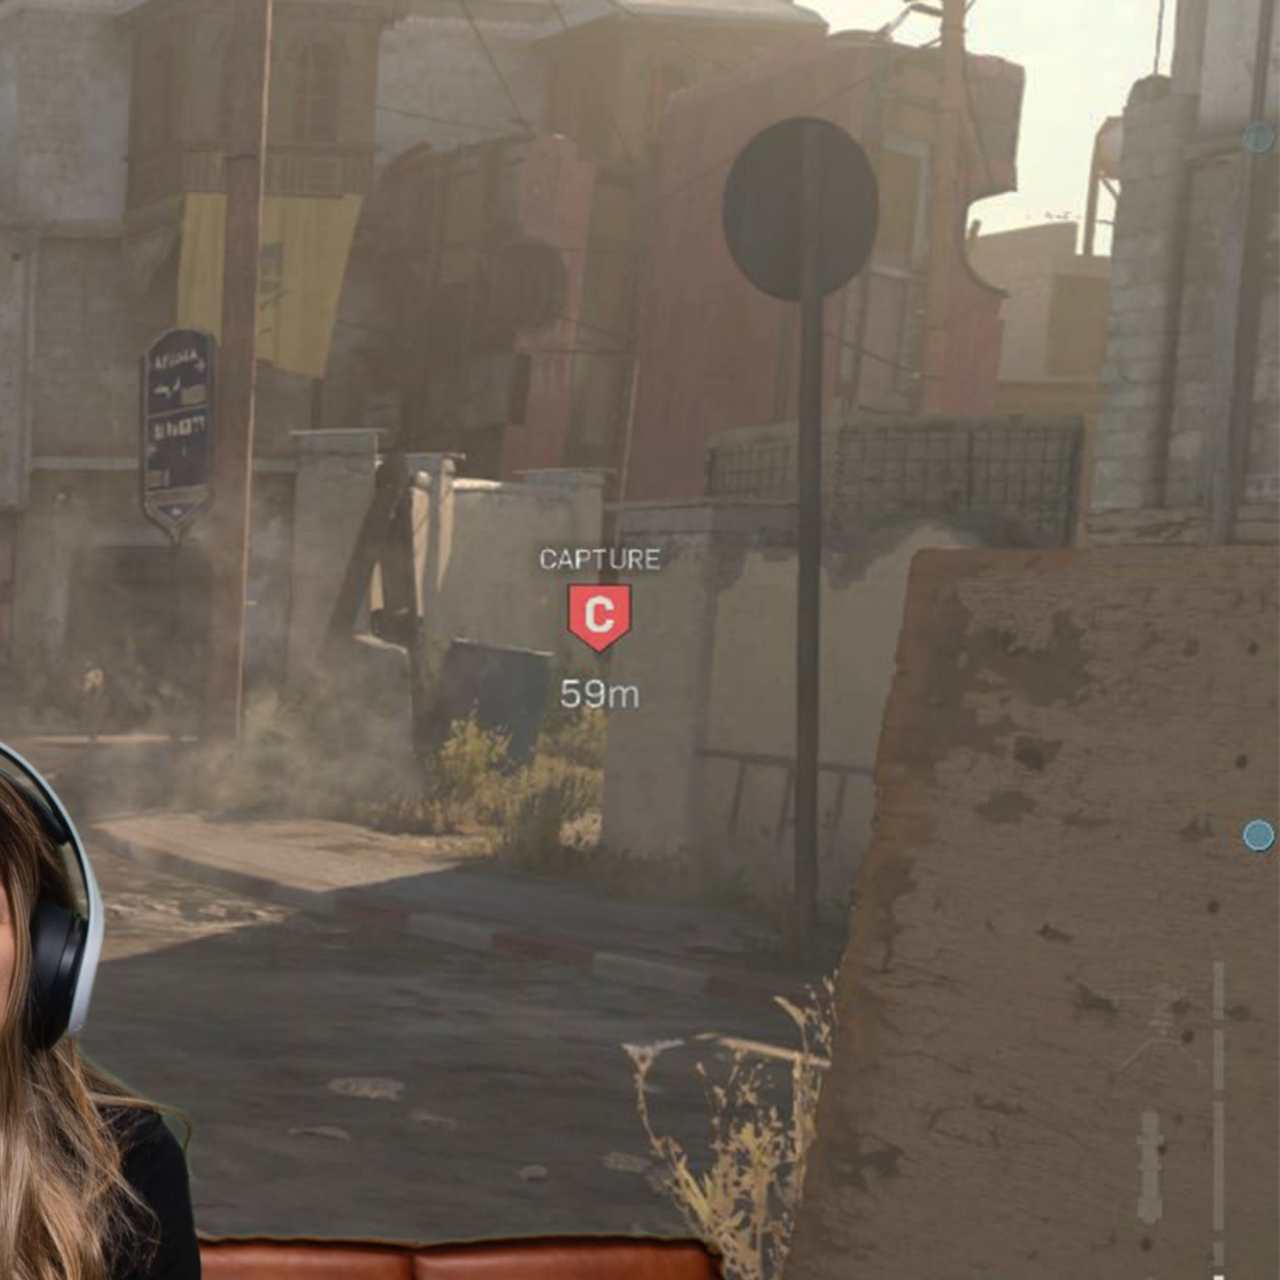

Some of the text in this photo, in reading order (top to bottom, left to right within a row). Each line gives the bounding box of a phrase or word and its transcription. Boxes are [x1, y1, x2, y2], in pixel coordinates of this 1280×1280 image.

[539, 548, 661, 571] CAPTURE
[584, 596, 616, 634] C
[559, 678, 639, 710] 59m
